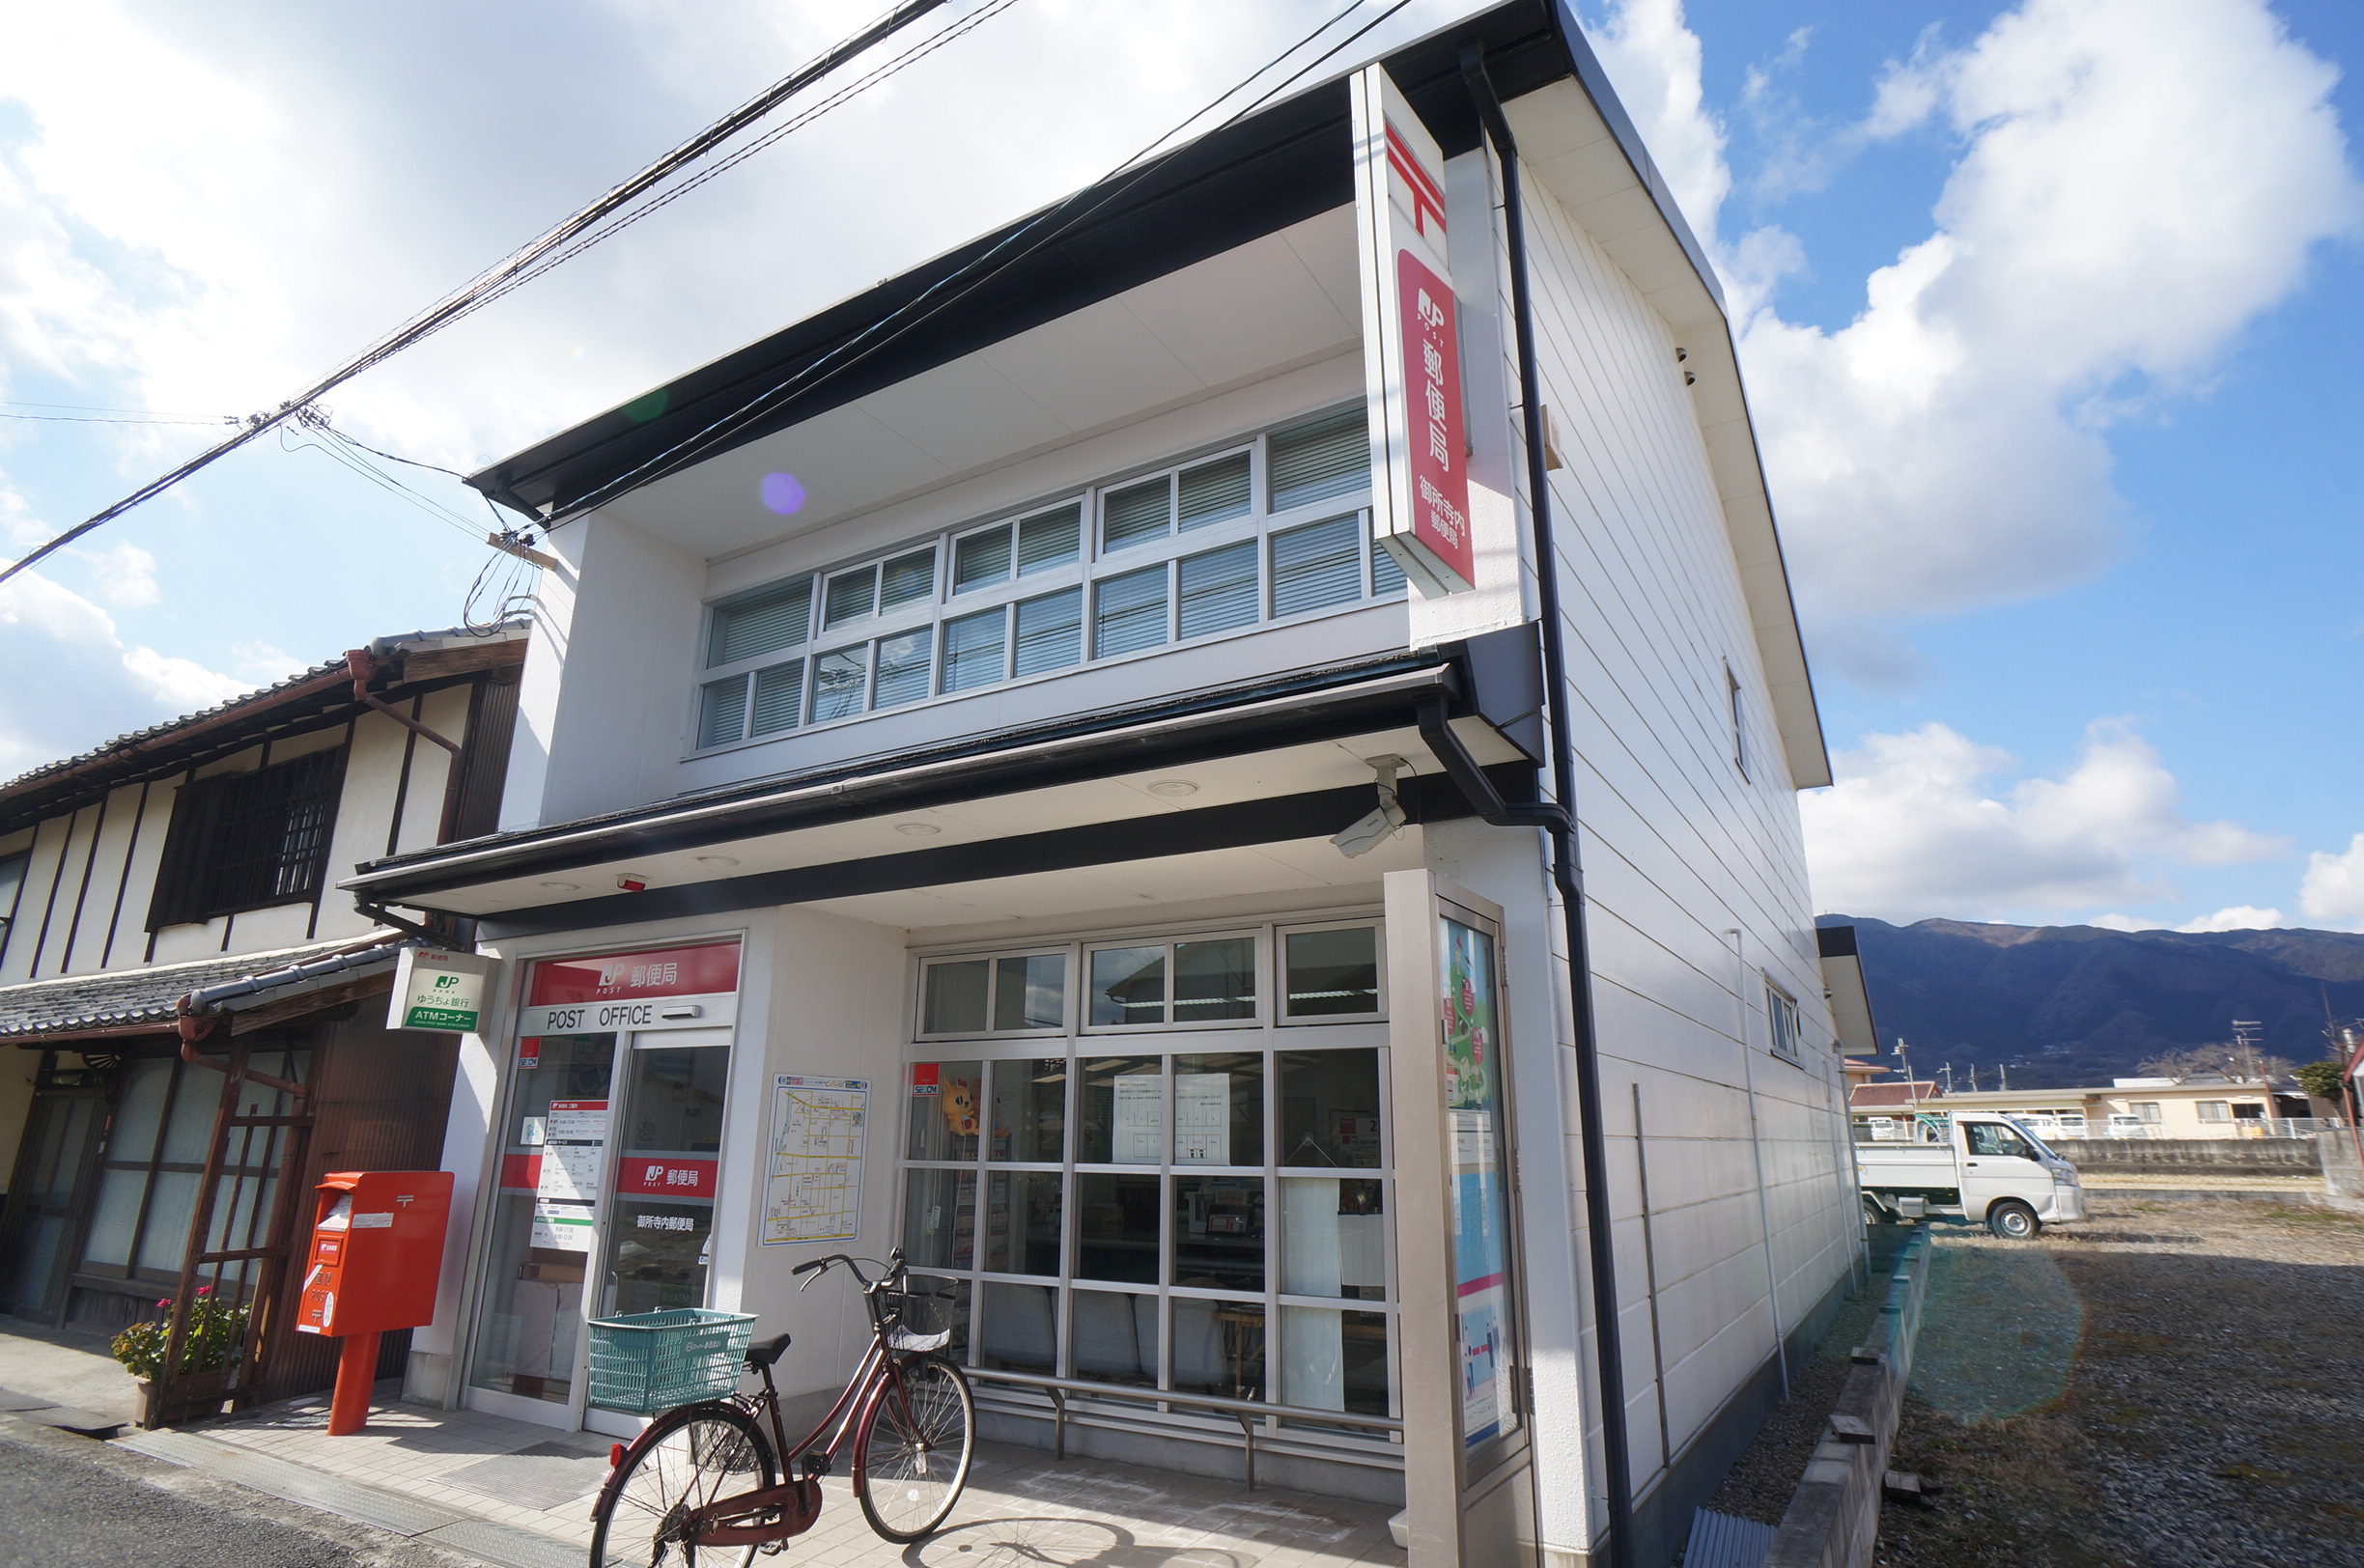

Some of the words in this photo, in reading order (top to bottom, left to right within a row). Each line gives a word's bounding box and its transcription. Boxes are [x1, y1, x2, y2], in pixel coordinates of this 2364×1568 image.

[1417, 313, 1445, 348] POST
[1423, 338, 1449, 473] 郵便局
[1420, 474, 1466, 537] 御所寺内
[1430, 510, 1458, 549] 郵便局
[630, 963, 678, 988] 郵便局
[596, 986, 622, 994] POST
[416, 994, 469, 1008] ゆうちょ銀行
[414, 1011, 471, 1022] ATMコーナー
[547, 1009, 585, 1030] POST
[599, 1004, 653, 1026] OFFICE
[915, 1085, 937, 1094] SECOM
[666, 1169, 698, 1187] 郵便局
[637, 1215, 694, 1232] 御所寺内郵便局
